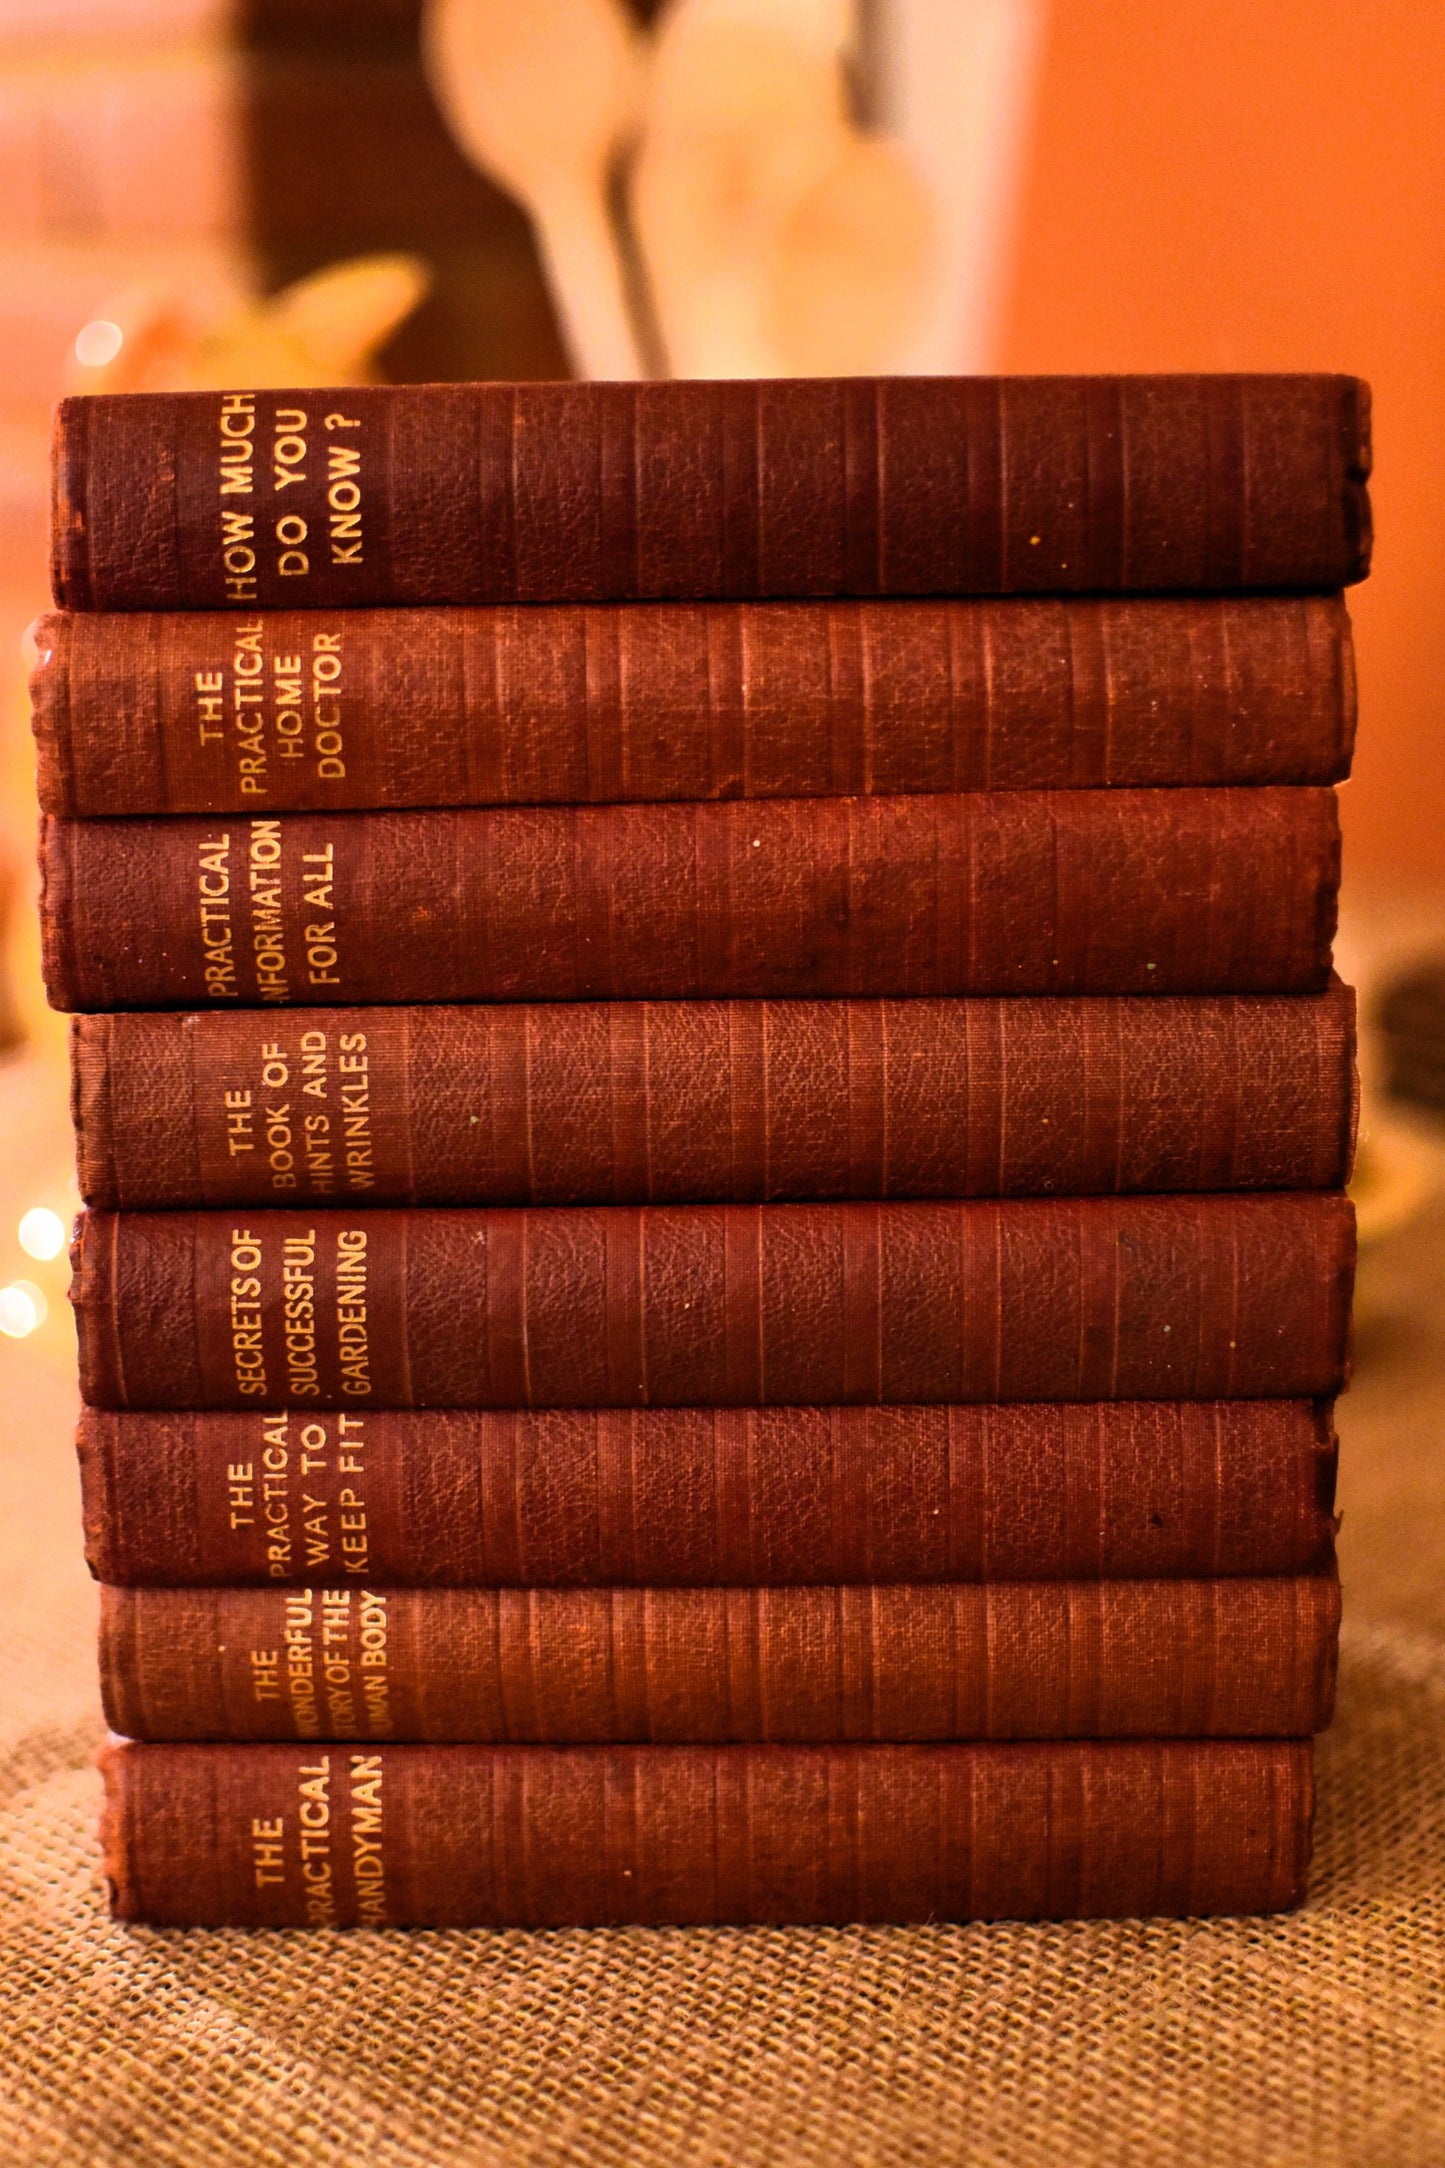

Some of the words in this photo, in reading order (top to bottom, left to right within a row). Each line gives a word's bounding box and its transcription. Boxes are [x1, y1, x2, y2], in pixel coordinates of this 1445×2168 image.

[220, 394, 255, 494] MUCH
[274, 409, 307, 491] YOU
[324, 413, 361, 431] ?
[328, 446, 363, 564] KNOW
[221, 511, 257, 599] HOW
[275, 515, 309, 576] DO
[195, 672, 224, 746] THE
[234, 619, 268, 793] PRACTICAL
[274, 654, 304, 758] HOME
[313, 633, 346, 778] DOCTOR
[249, 820, 290, 1001] NFORMATION
[302, 843, 333, 910] ALL
[199, 834, 238, 997] PRACTICAL
[304, 922, 340, 984] FOR
[262, 1043, 288, 1088] OF
[300, 1031, 327, 1098] AND
[224, 1090, 254, 1156] THE
[265, 1104, 297, 1188] BOOK
[338, 1033, 375, 1190] WRINKLES
[304, 1115, 335, 1194] HINTS
[231, 1229, 262, 1271] OF
[231, 1278, 267, 1395] SECRETS
[283, 1229, 320, 1396] SUCCESSFUL
[336, 1230, 371, 1395] GARDENING
[300, 1424, 327, 1475] TO
[339, 1413, 364, 1473] FIT
[228, 1462, 255, 1530] THE
[263, 1409, 292, 1578] PRACTICAL
[302, 1494, 330, 1566] WAY
[340, 1488, 369, 1573] KEEP
[322, 1590, 350, 1645] THE
[360, 1590, 387, 1667] BODY
[251, 1650, 280, 1702] THE
[323, 1651, 350, 1684] OF
[252, 1817, 285, 1888] THE
